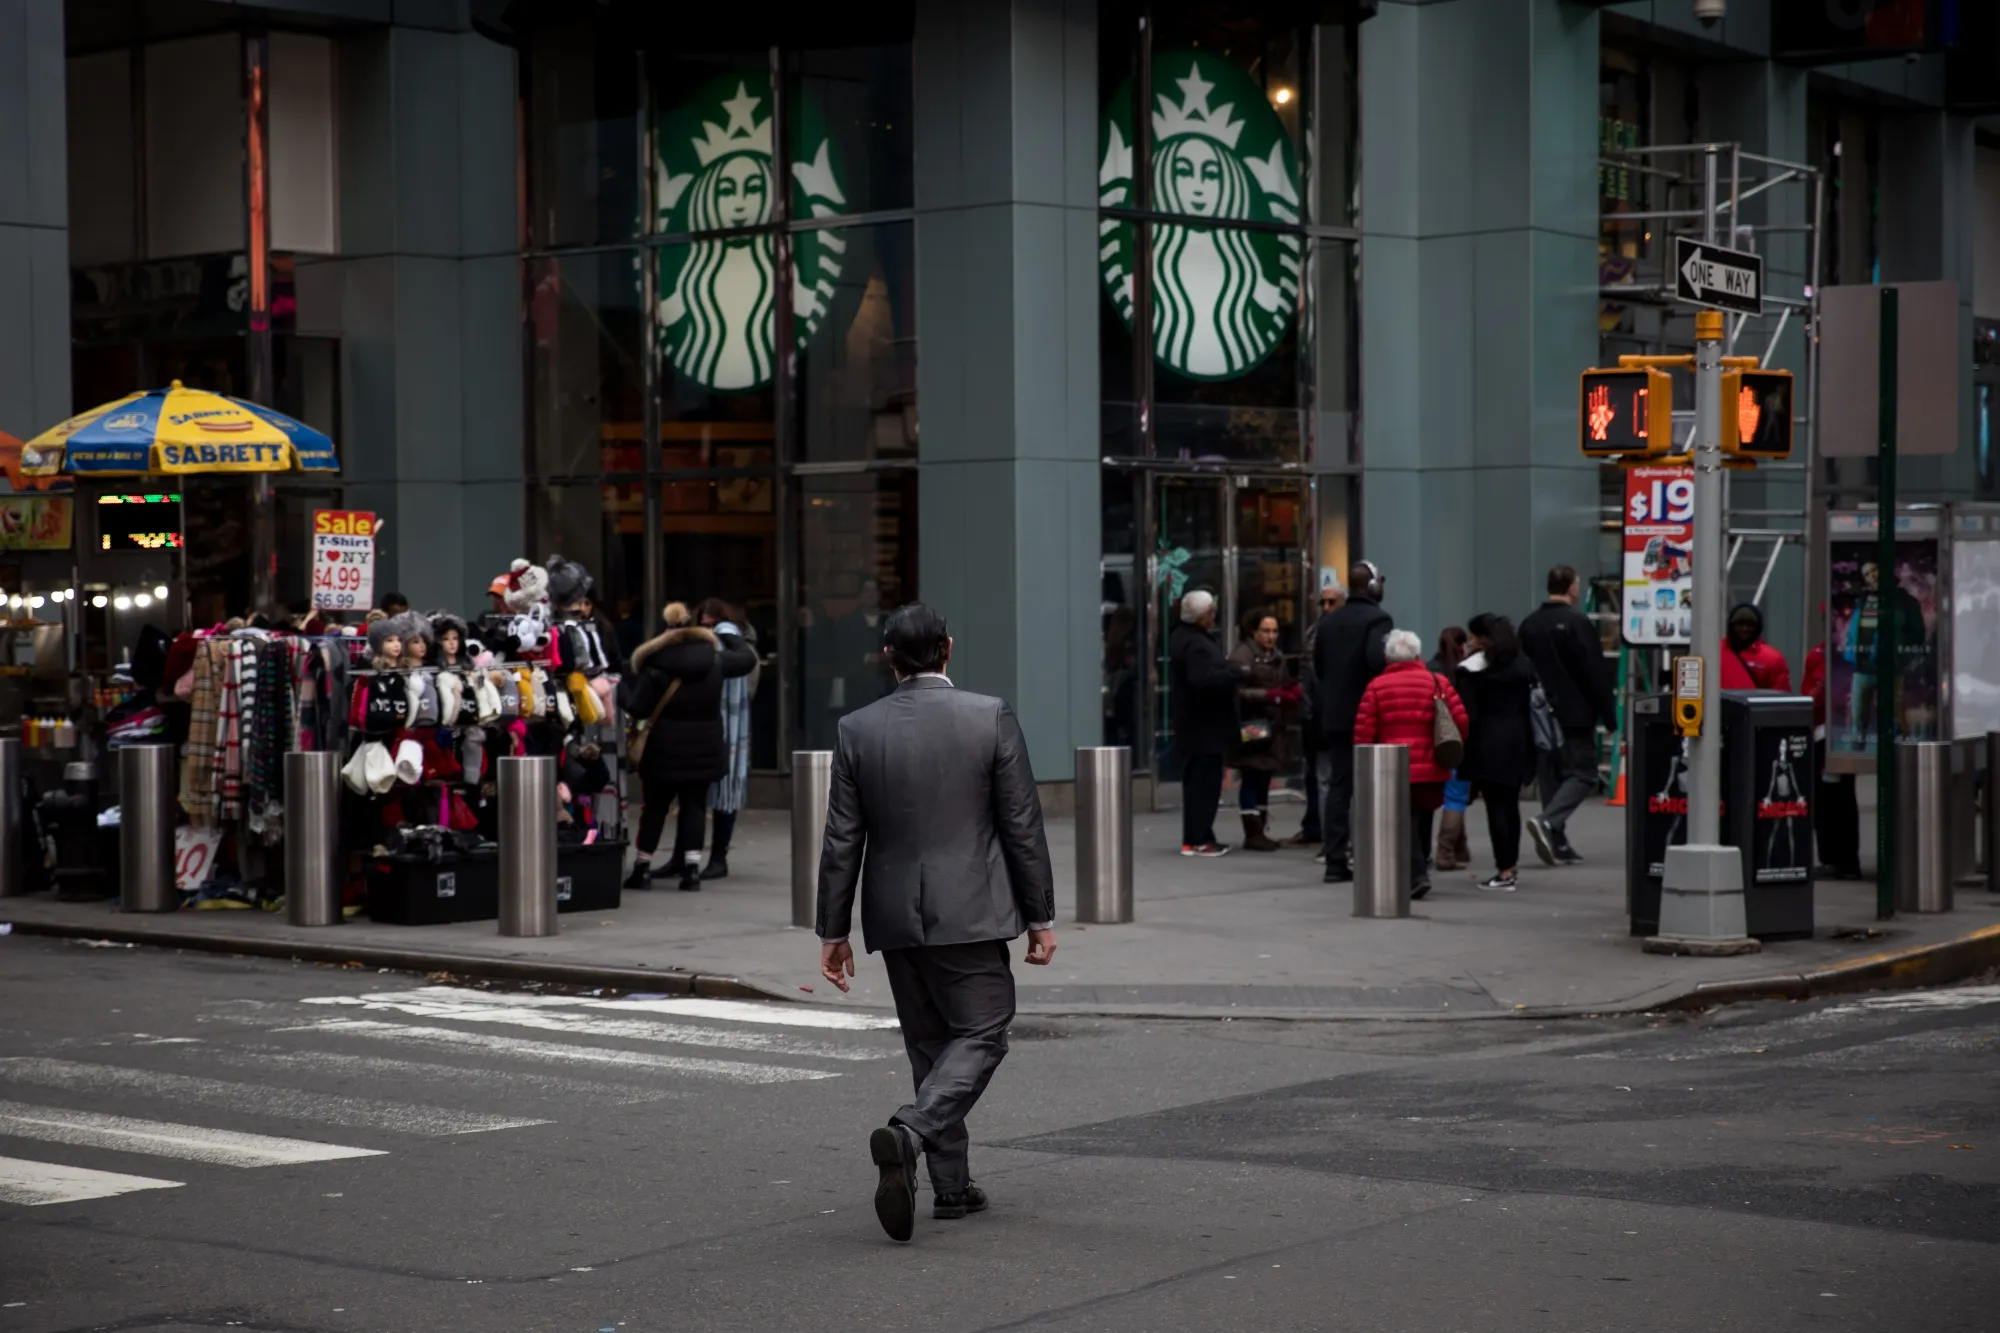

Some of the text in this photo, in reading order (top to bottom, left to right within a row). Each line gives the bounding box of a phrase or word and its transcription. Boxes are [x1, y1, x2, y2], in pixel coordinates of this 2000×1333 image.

[1689, 261, 1751, 294] ONE WAY
[164, 443, 284, 465] SABRETT
[1629, 478, 1694, 523] $19
[316, 511, 371, 535] Sale
[317, 536, 370, 548] T-Shirt
[316, 550, 371, 564] I NY
[314, 566, 361, 591] $4.99
[314, 593, 355, 609] $6.99
[1836, 644, 1877, 654] AMERIC
[1757, 800, 1809, 819] CHICAGO
